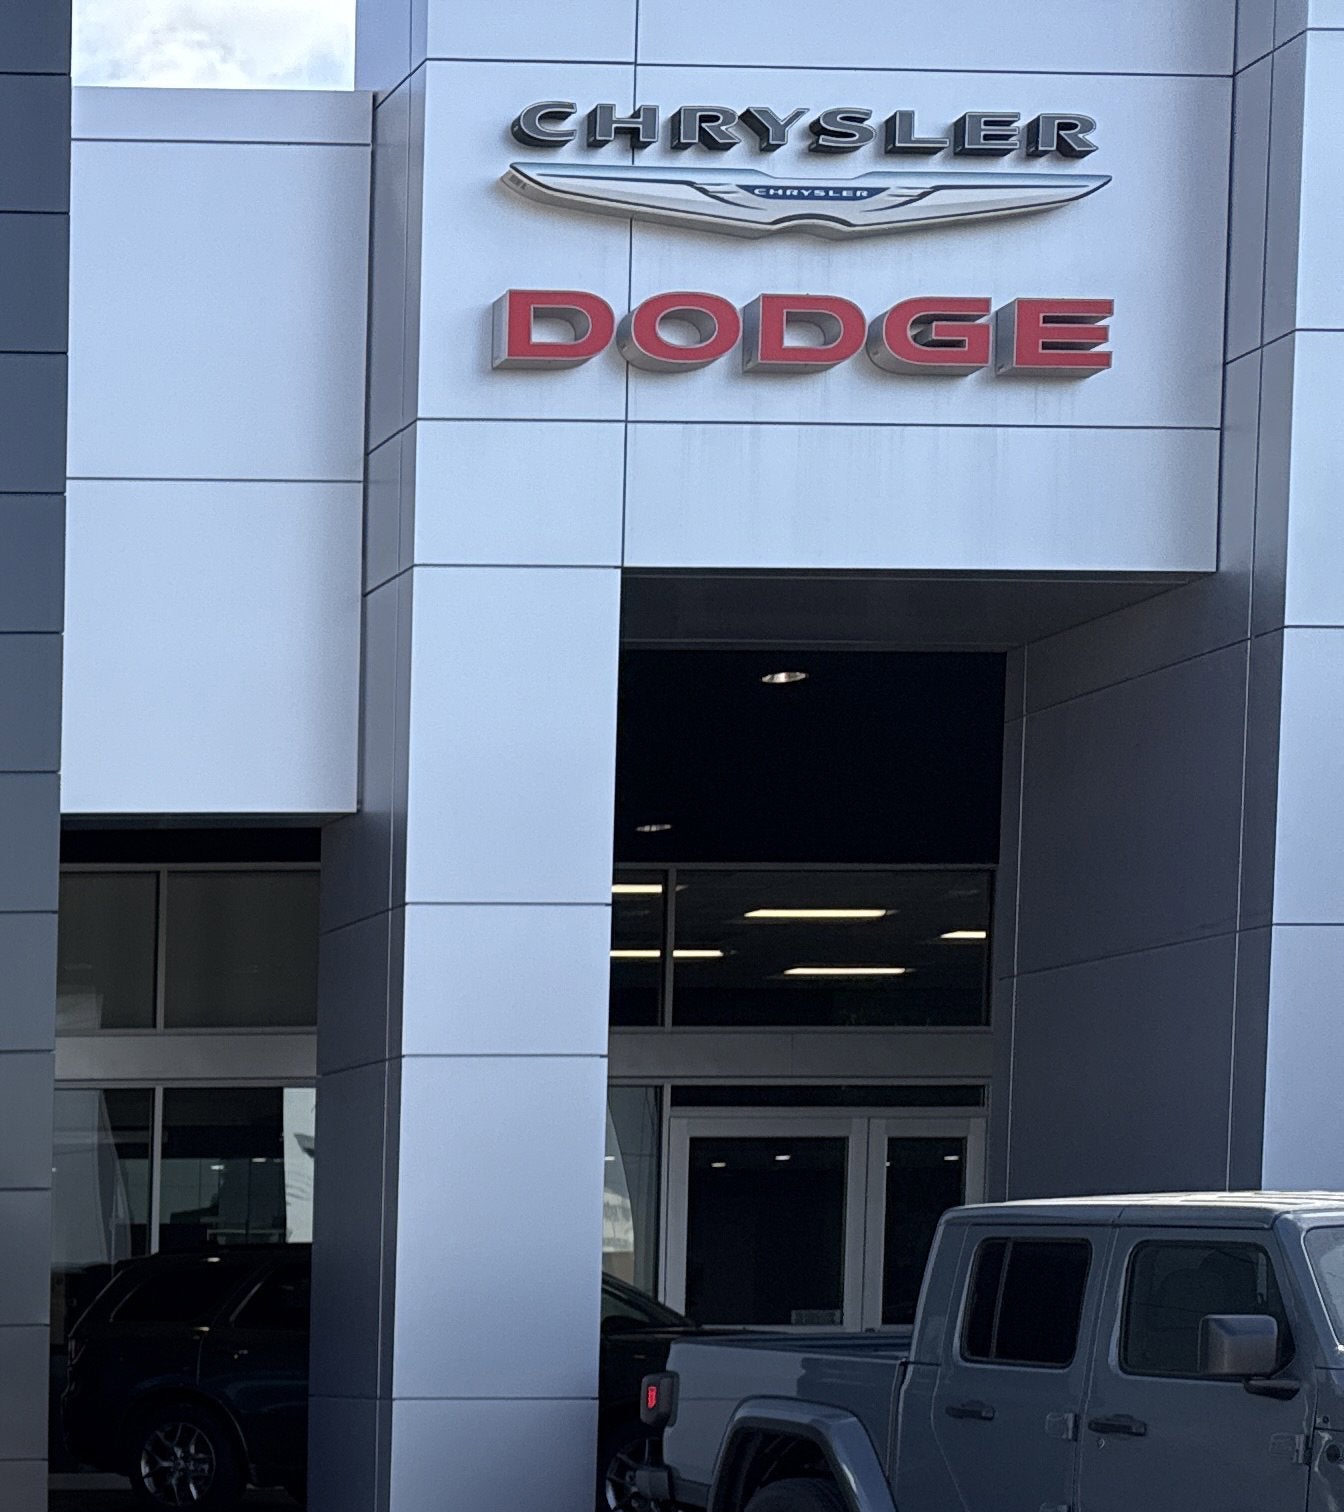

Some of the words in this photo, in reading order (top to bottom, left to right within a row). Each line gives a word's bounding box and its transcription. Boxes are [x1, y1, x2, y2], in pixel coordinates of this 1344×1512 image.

[512, 101, 1099, 159] CHRYSLER
[753, 187, 870, 199] CHRYSLER
[492, 289, 1115, 378] DODGE
